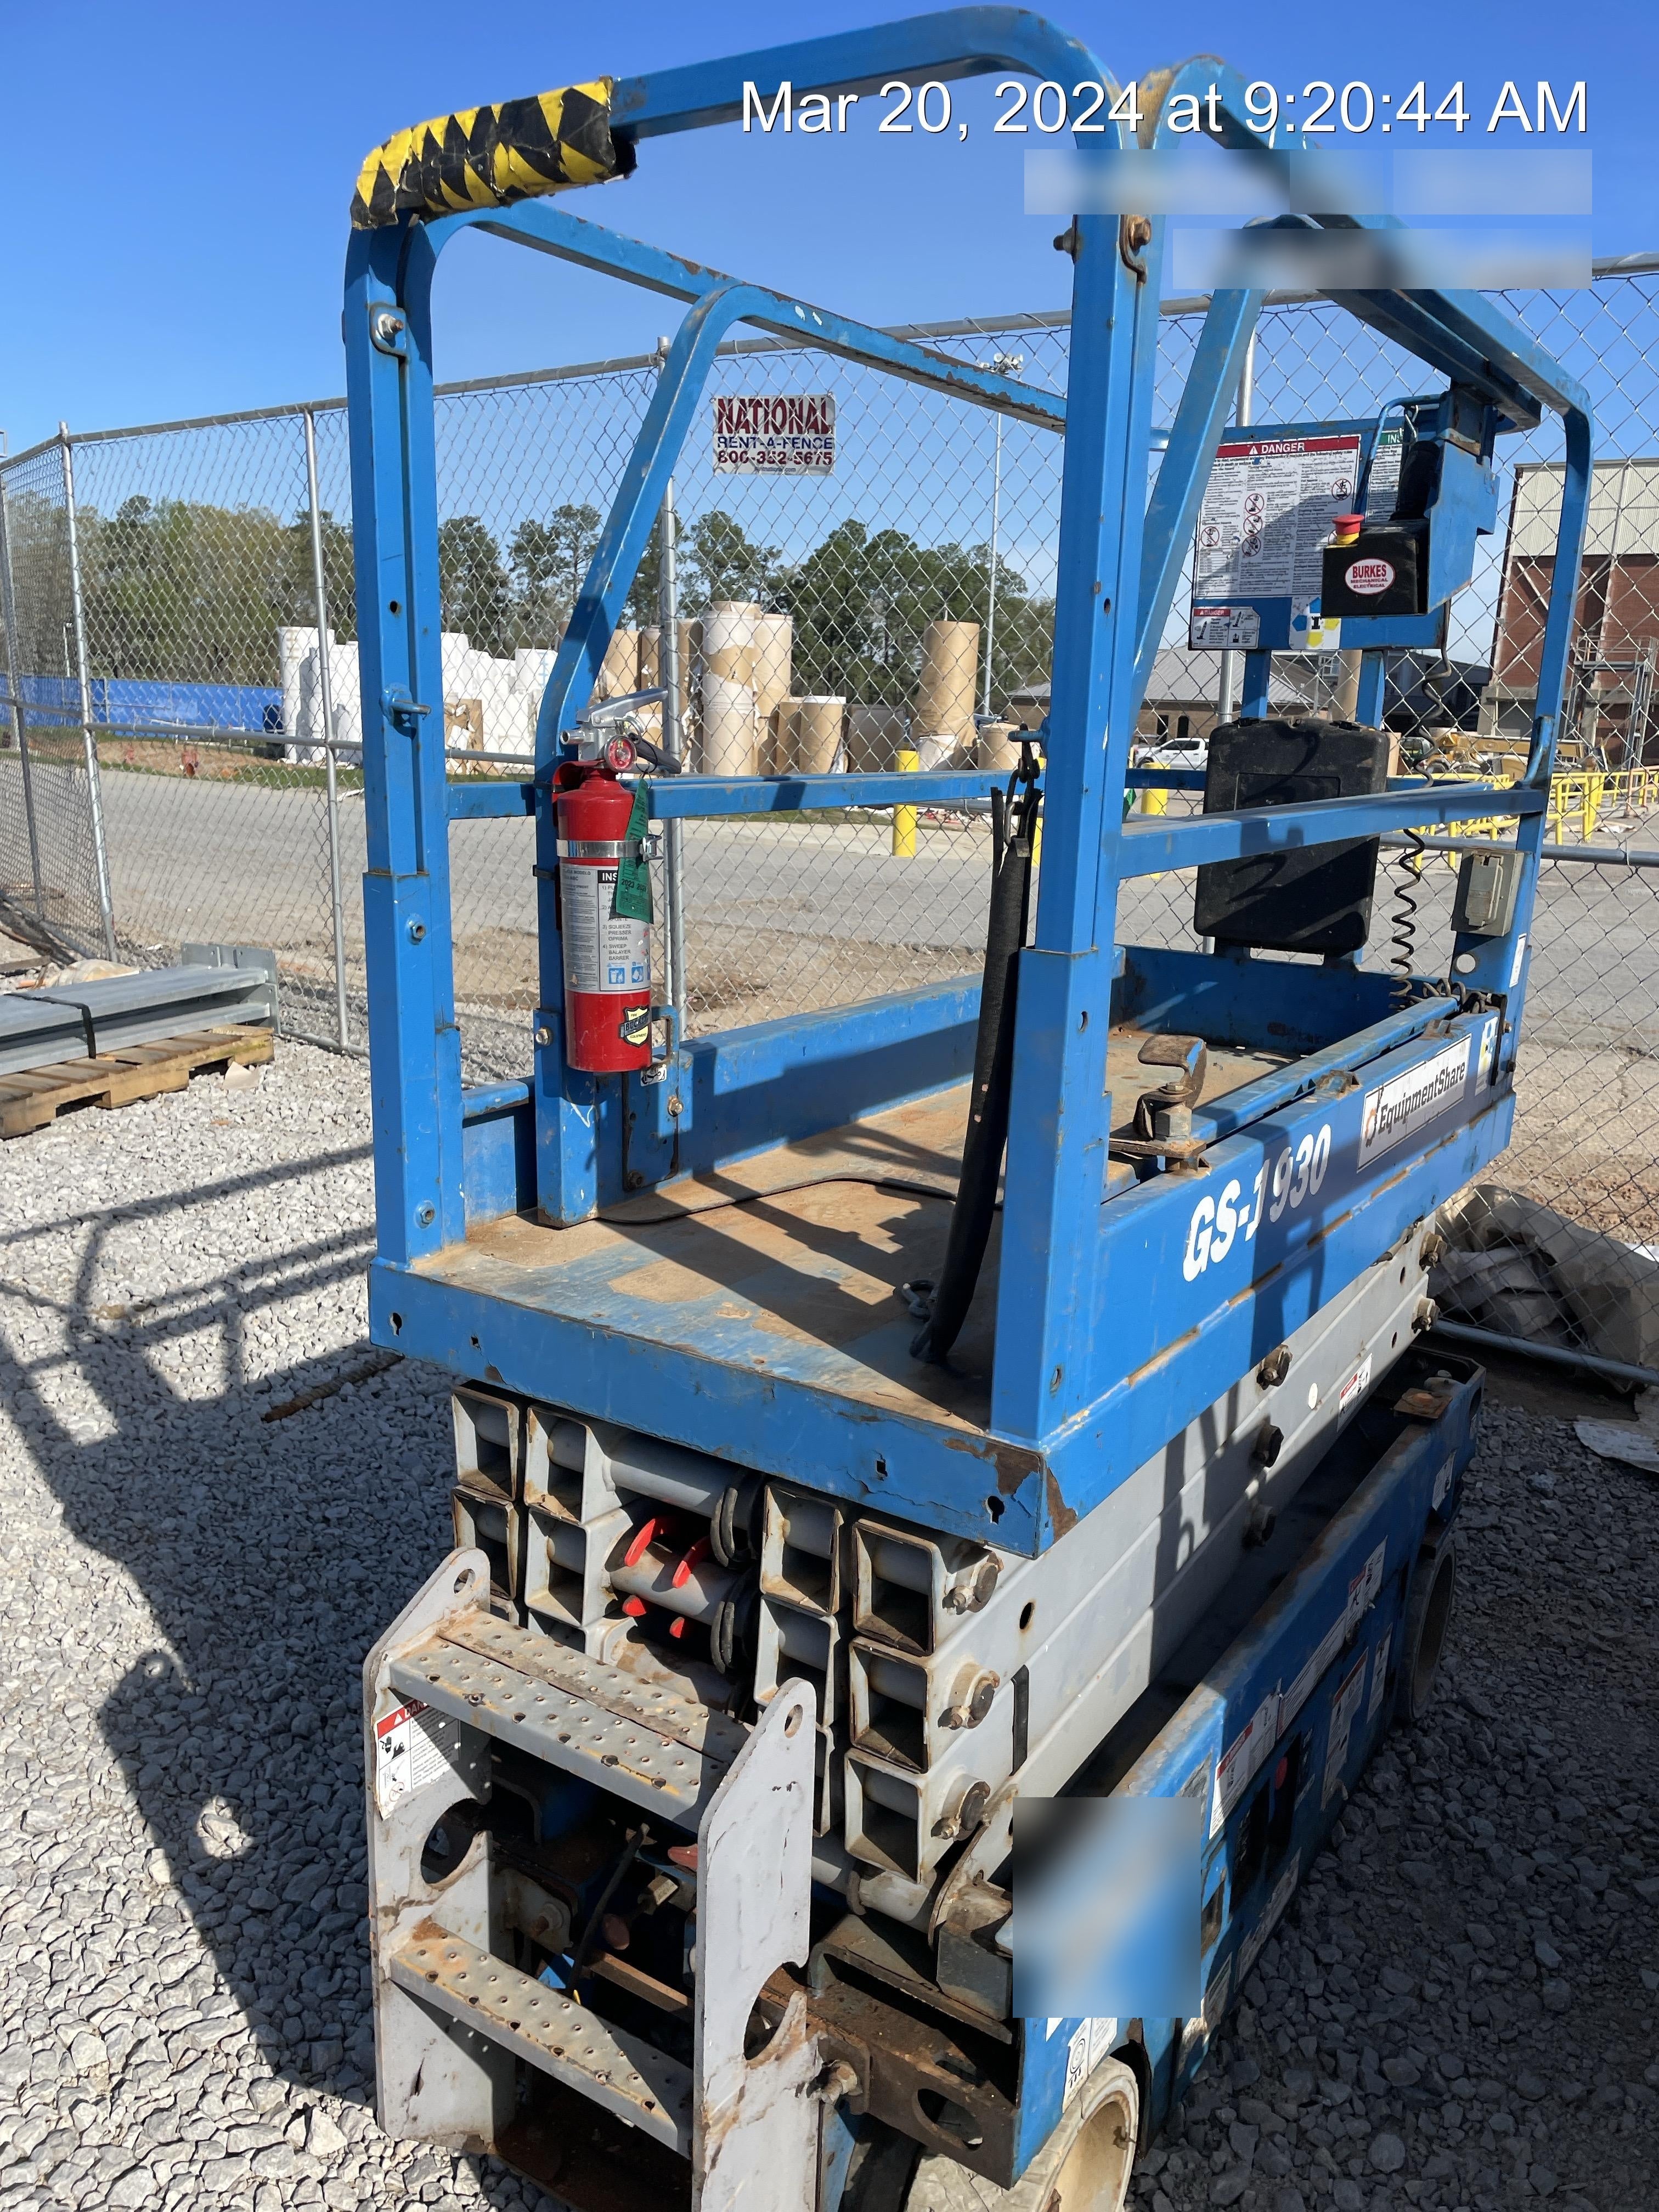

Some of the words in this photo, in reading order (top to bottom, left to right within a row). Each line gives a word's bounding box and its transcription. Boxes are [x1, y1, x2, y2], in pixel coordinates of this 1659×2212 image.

[718, 398, 833, 435] NATIONAL
[717, 436, 833, 449] RENT-A-FENCE
[1261, 442, 1305, 454] DANGER
[1352, 564, 1387, 579] BURKES
[1378, 1061, 1465, 1135] EquipmentShare
[1182, 1123, 1331, 1282] GS-1930
[404, 1700, 427, 1719] DAN
